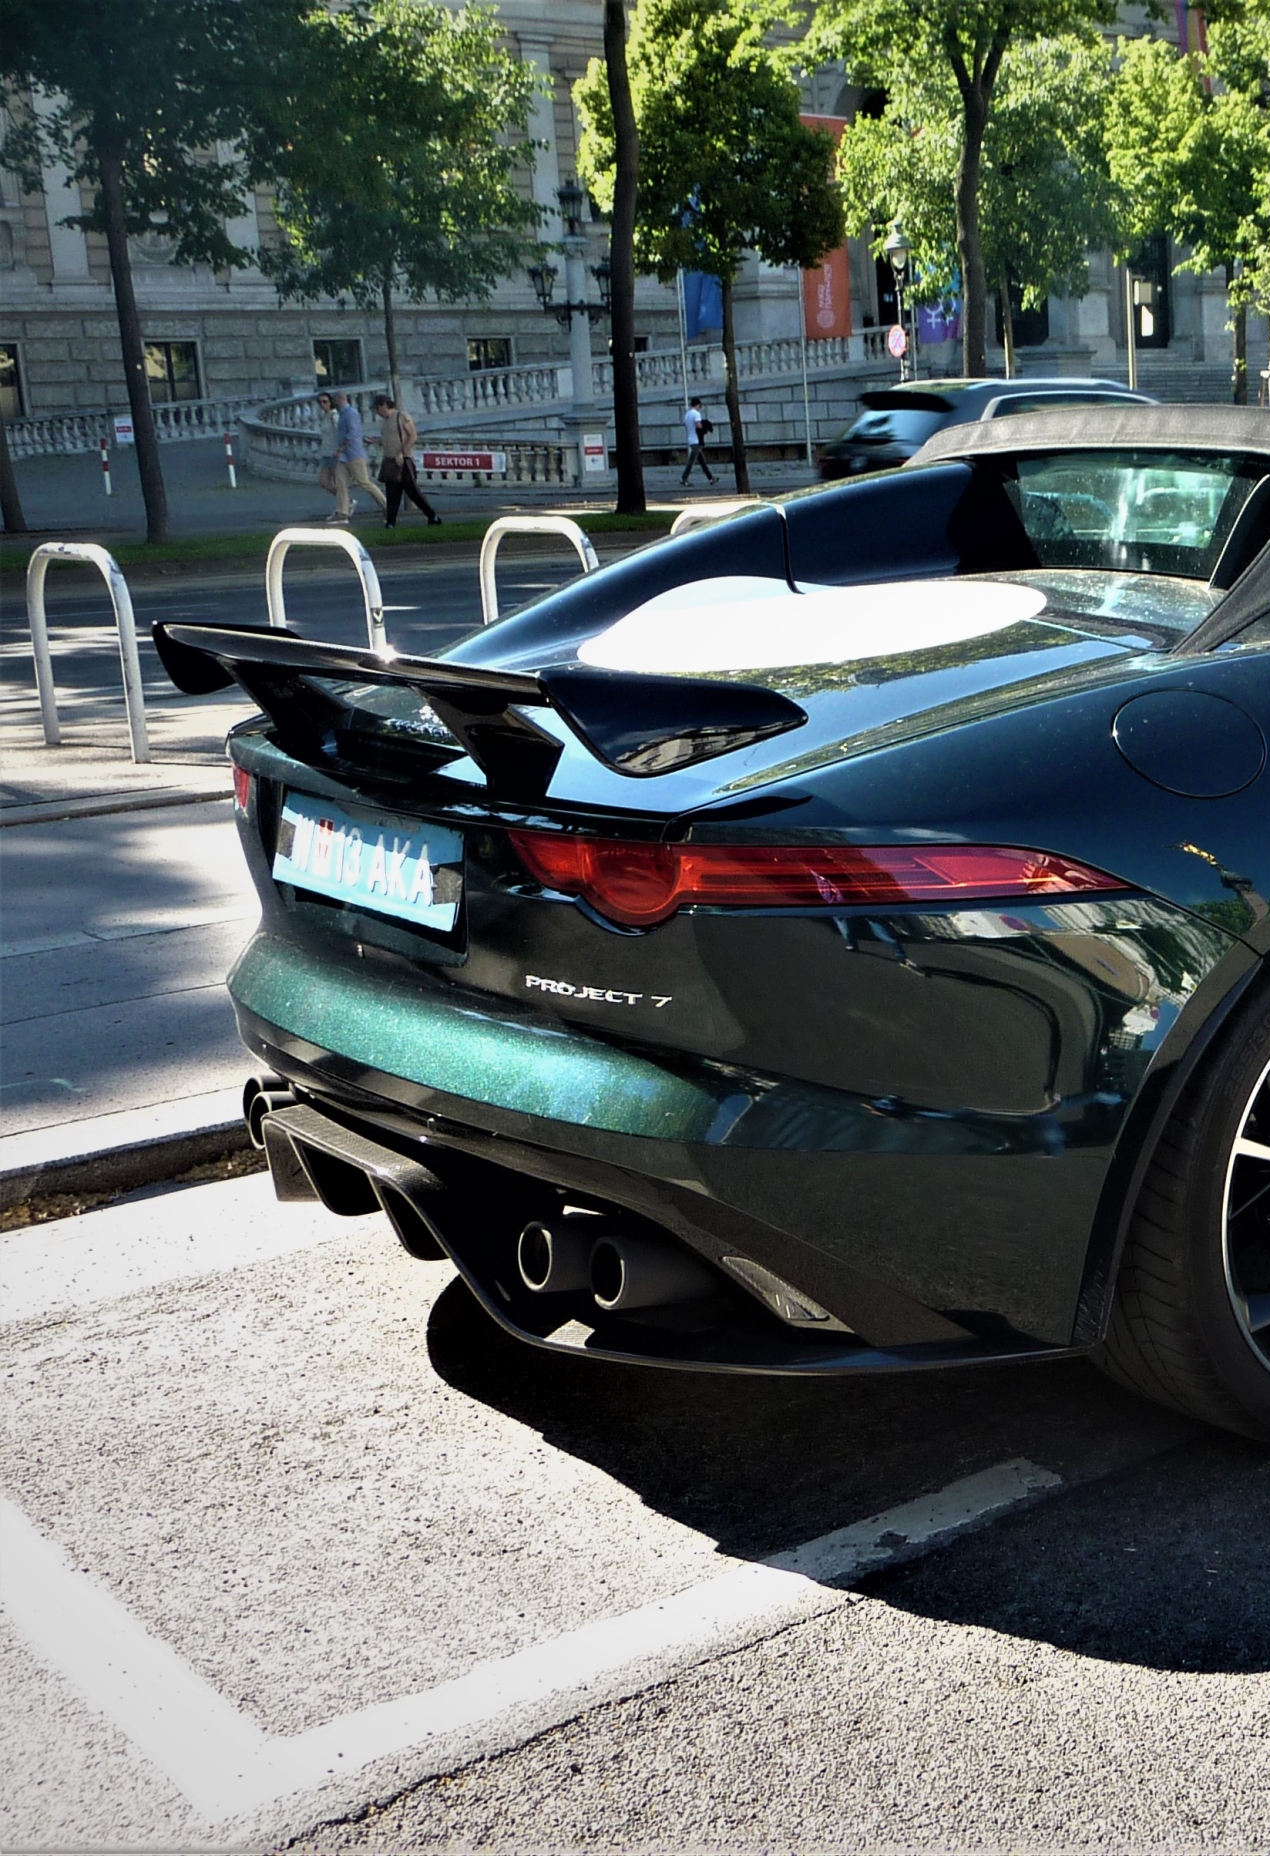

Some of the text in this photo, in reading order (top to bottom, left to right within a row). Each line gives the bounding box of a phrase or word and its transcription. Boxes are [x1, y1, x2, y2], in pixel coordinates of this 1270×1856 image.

[435, 457, 473, 467] SEKTOR
[368, 831, 434, 907] AKA
[525, 975, 673, 1008] PROJECT 7
